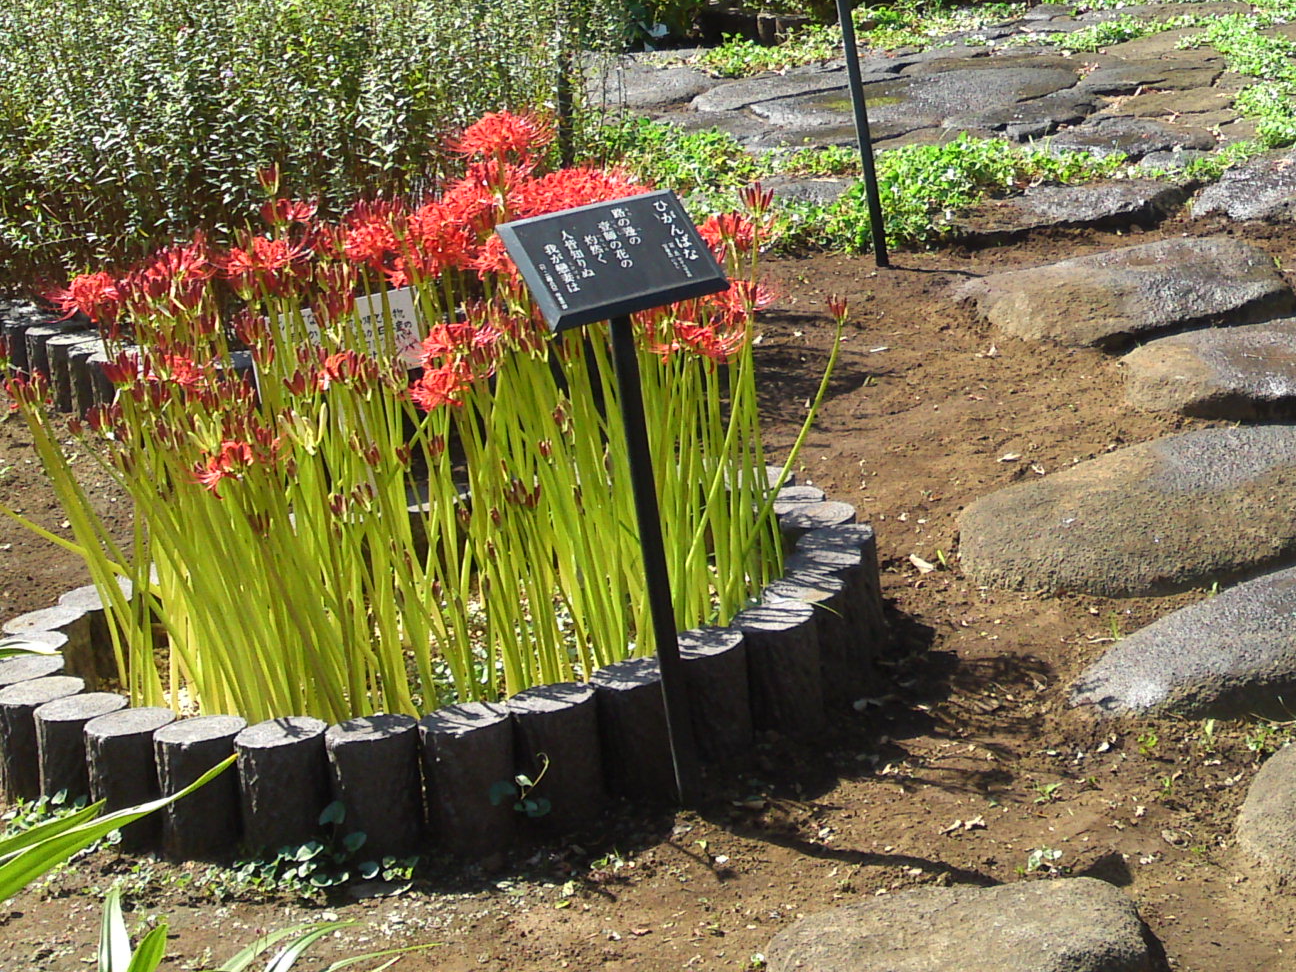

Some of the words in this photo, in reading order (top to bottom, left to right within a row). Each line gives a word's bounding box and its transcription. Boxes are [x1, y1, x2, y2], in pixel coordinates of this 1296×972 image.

[560, 230, 596, 278] 人皆知りぬ
[583, 234, 608, 264] 灼然く
[653, 200, 699, 260] ひがんばな
